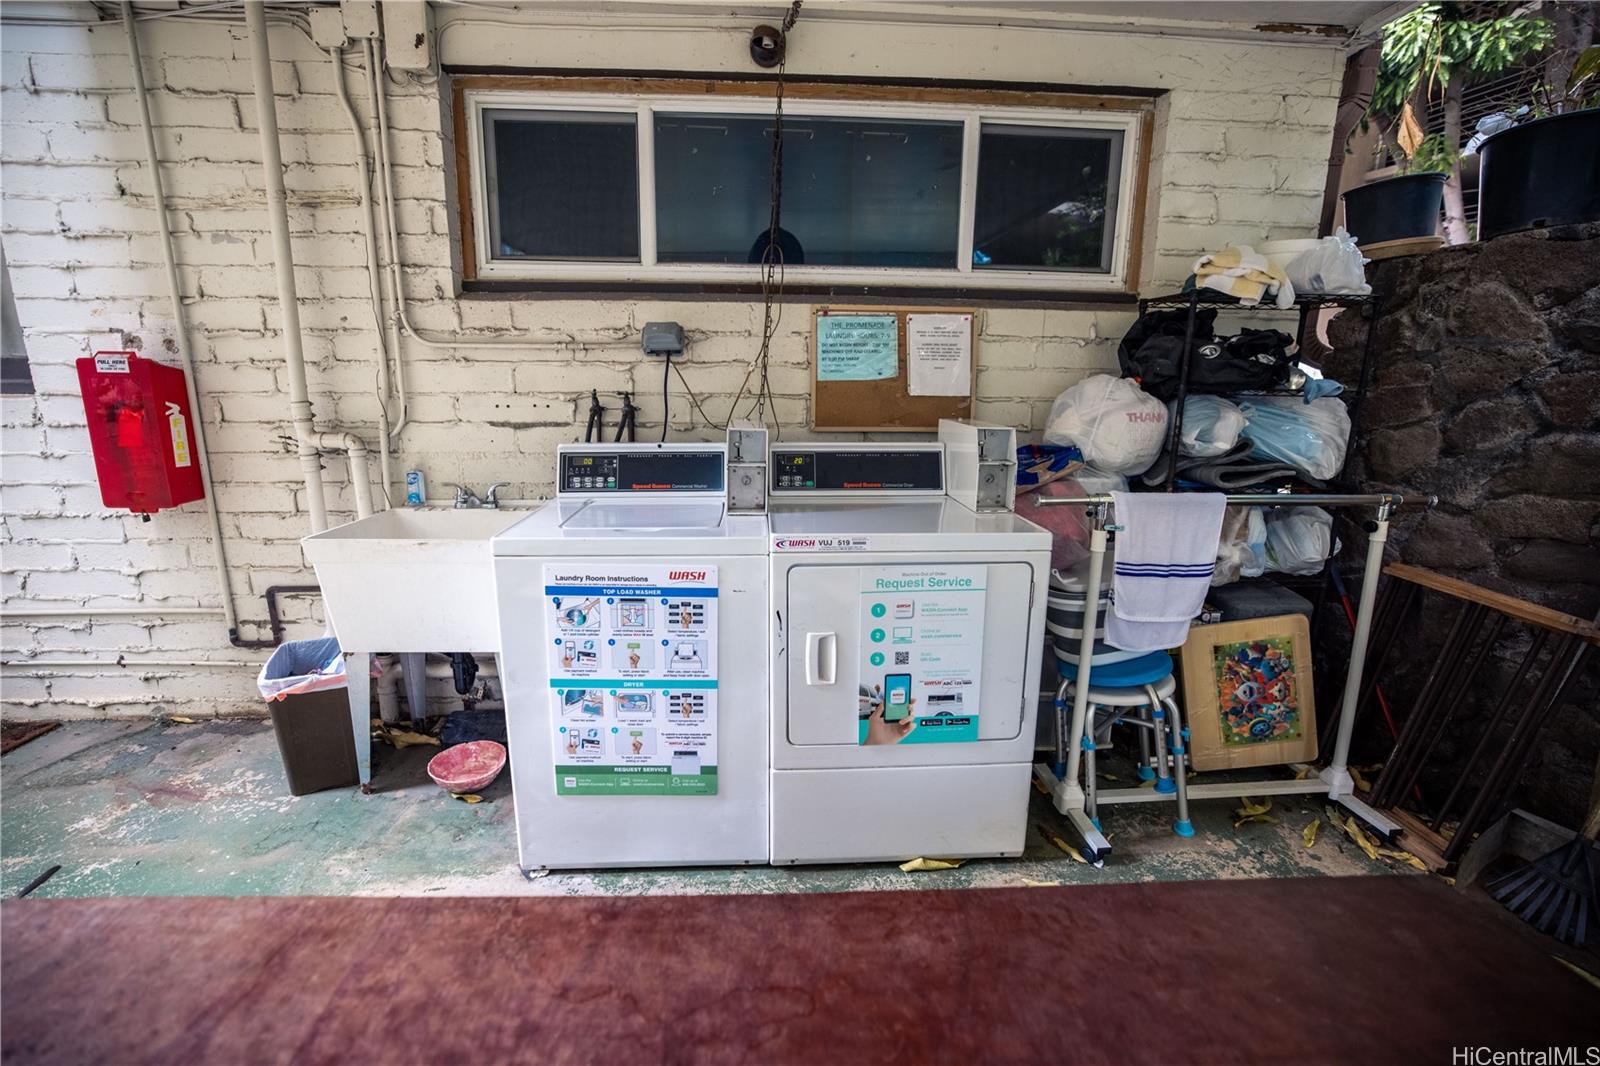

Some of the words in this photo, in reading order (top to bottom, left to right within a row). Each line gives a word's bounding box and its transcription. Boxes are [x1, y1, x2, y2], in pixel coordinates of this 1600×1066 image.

[173, 417, 188, 463] FIRE
[555, 574, 583, 583] Laundry
[669, 571, 706, 581] WASH
[875, 578, 925, 590] Request
[928, 577, 972, 587] Service
